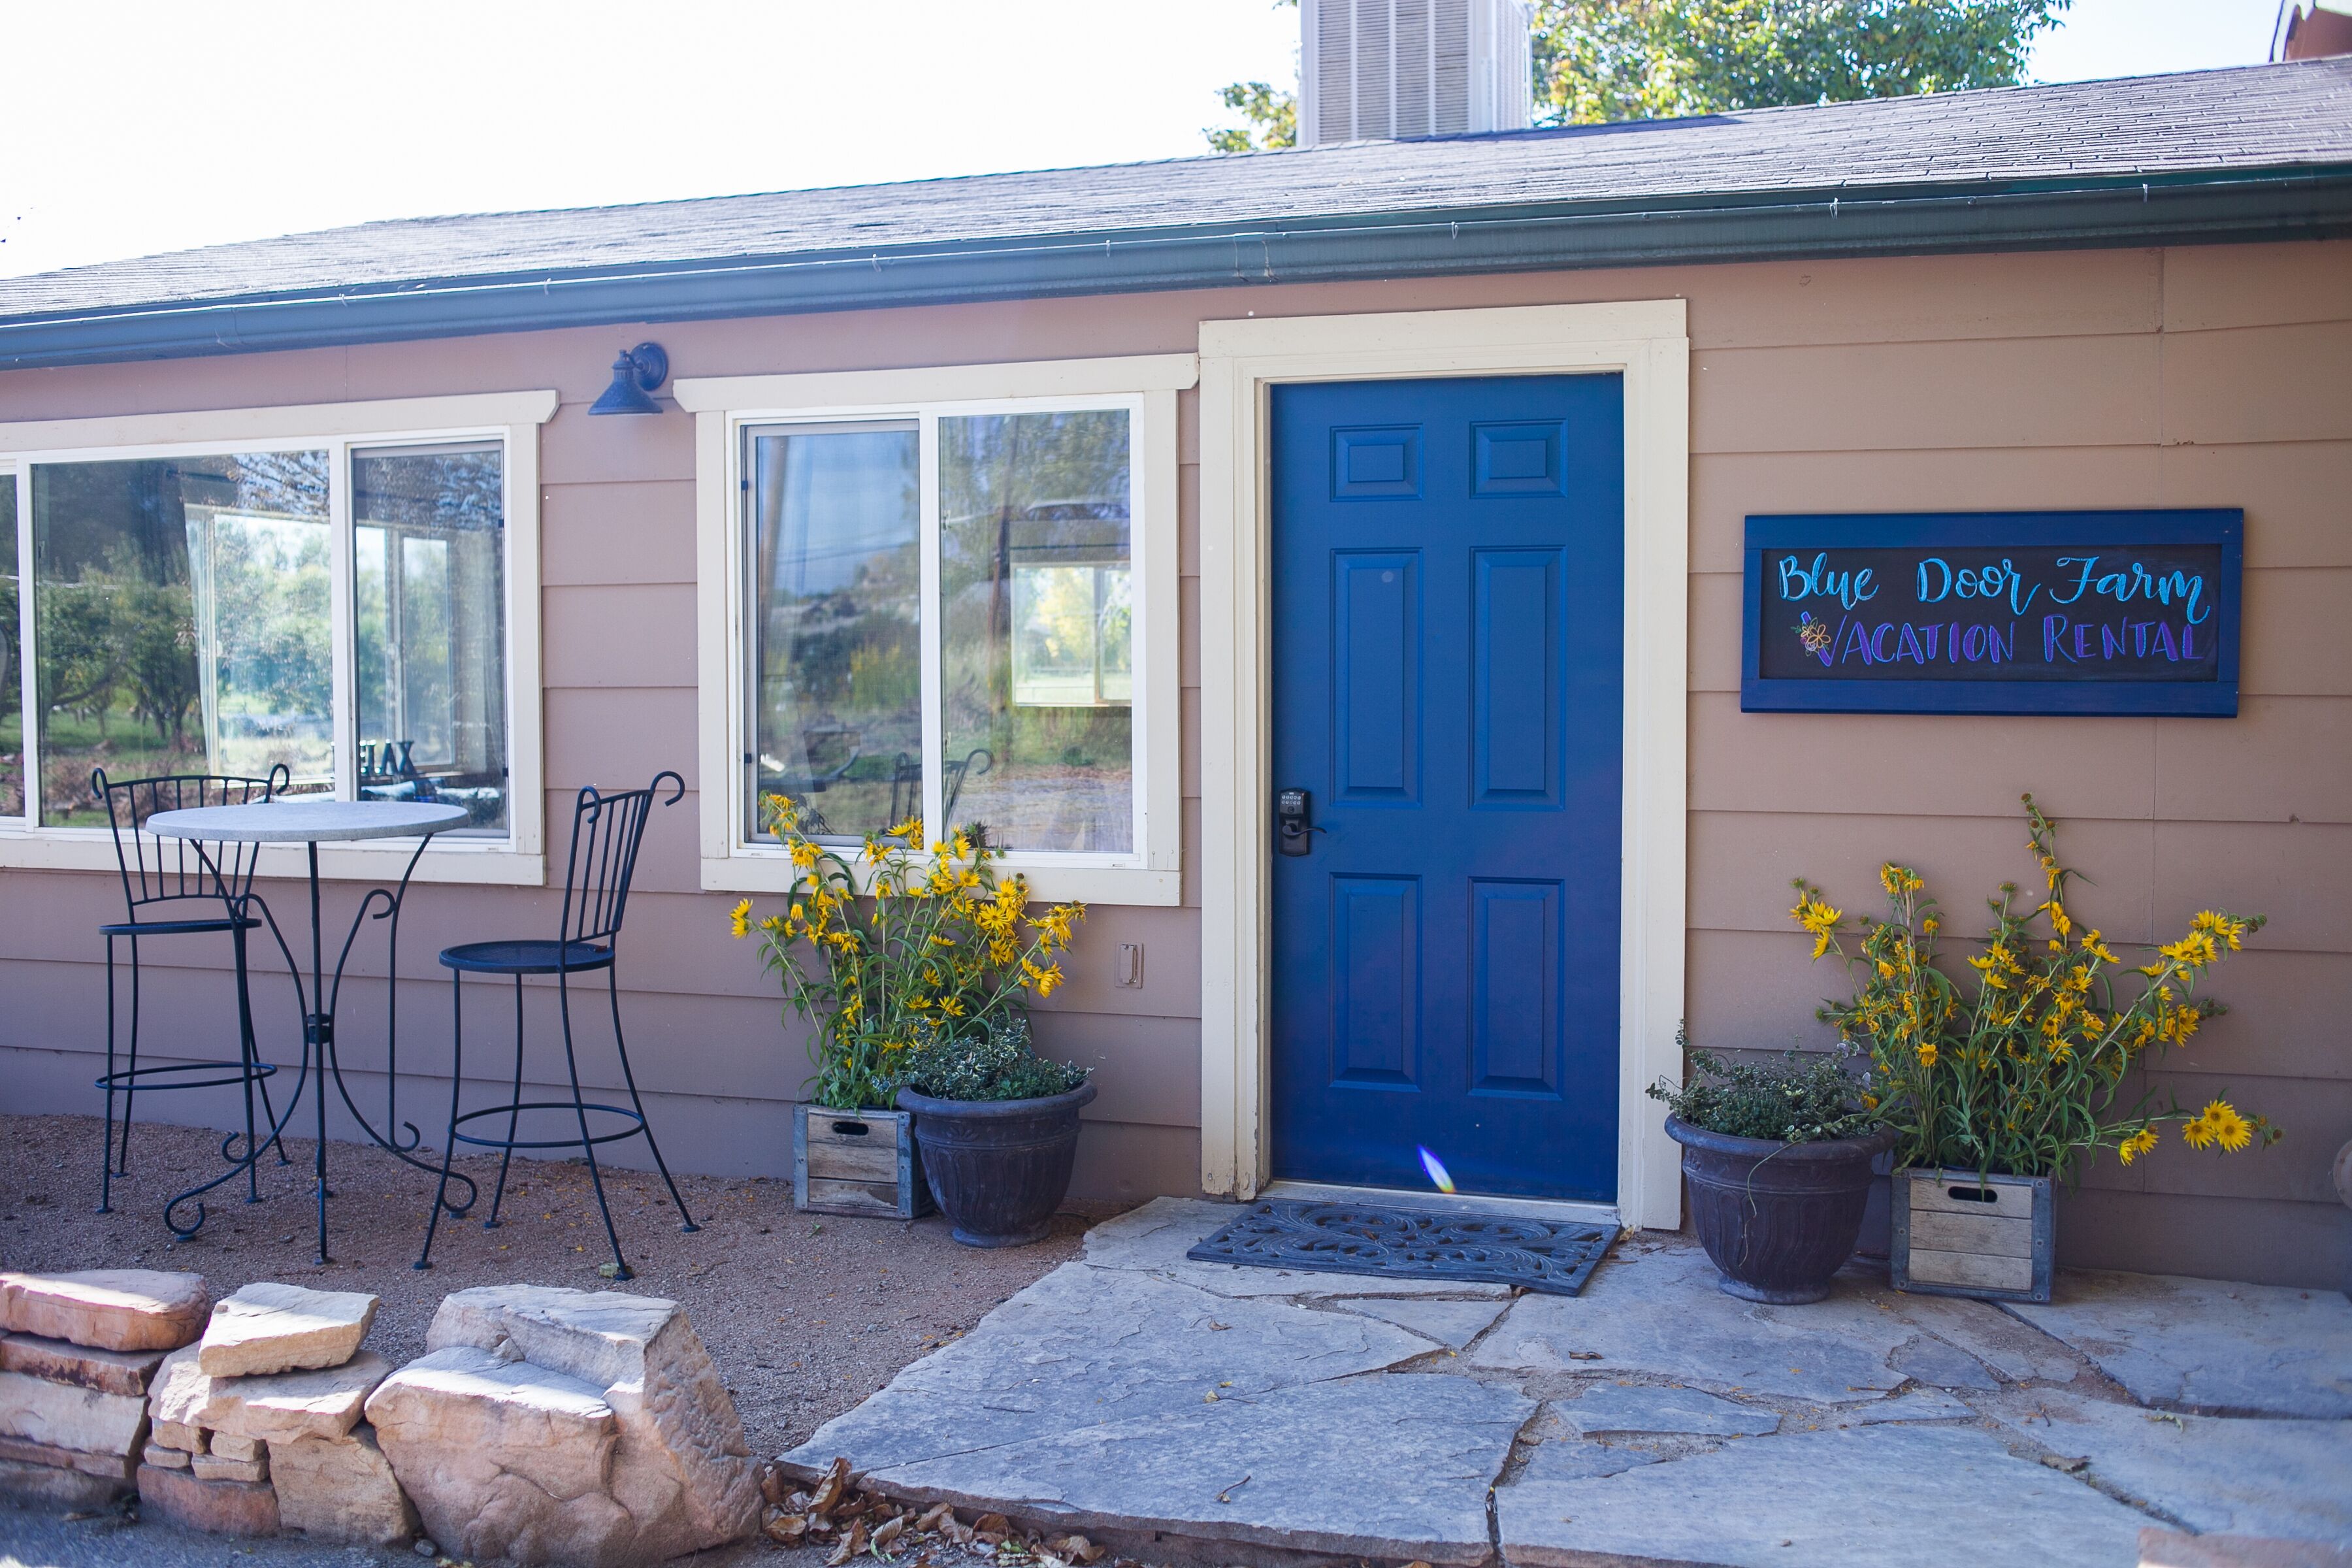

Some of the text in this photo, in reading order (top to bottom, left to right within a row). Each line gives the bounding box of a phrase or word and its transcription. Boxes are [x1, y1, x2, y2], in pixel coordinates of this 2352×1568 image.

[1778, 551, 2211, 625] Blue Door Farm
[1798, 610, 2204, 667] VACATION RENTAL
